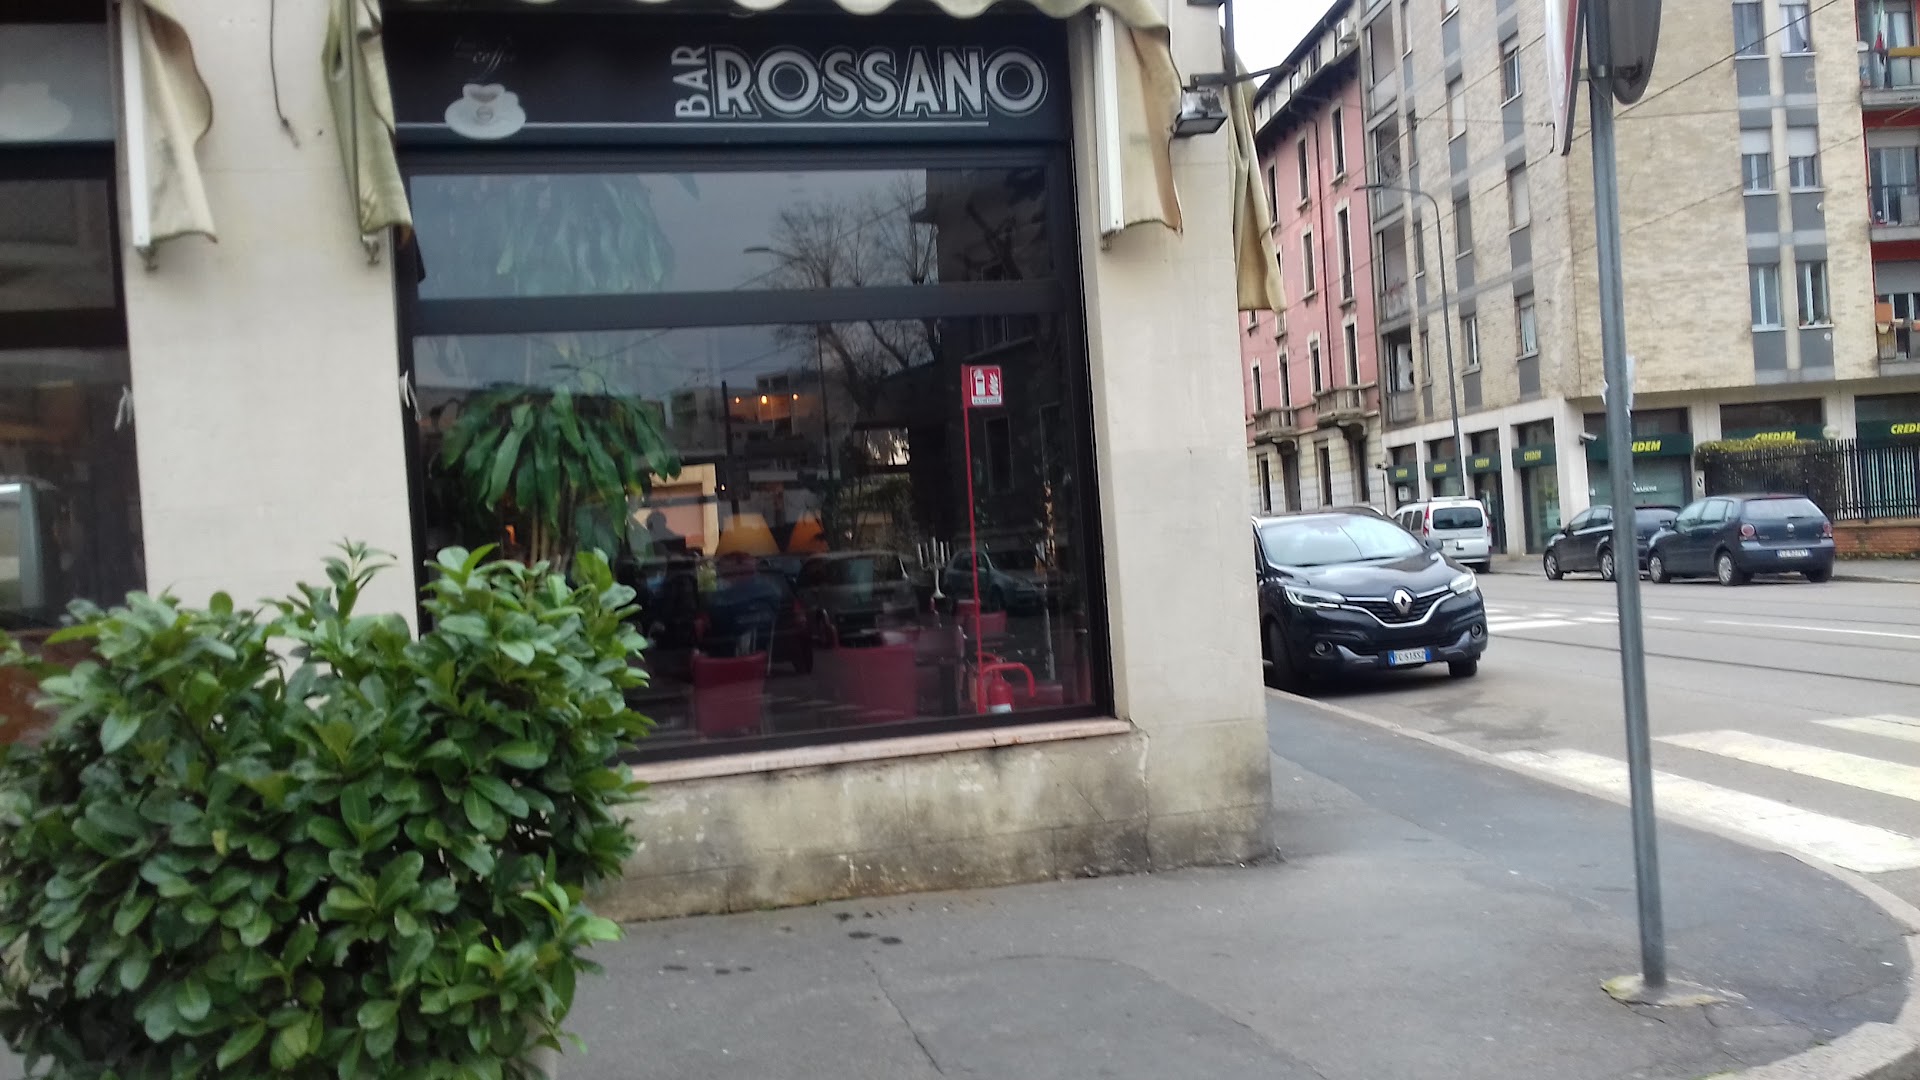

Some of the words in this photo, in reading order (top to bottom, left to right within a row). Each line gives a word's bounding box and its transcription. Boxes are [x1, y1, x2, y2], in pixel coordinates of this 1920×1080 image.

[671, 46, 710, 117] BAR
[711, 46, 1048, 117] ROSSANO
[1631, 440, 1661, 453] EDEM
[1890, 422, 1920, 435] CREDE
